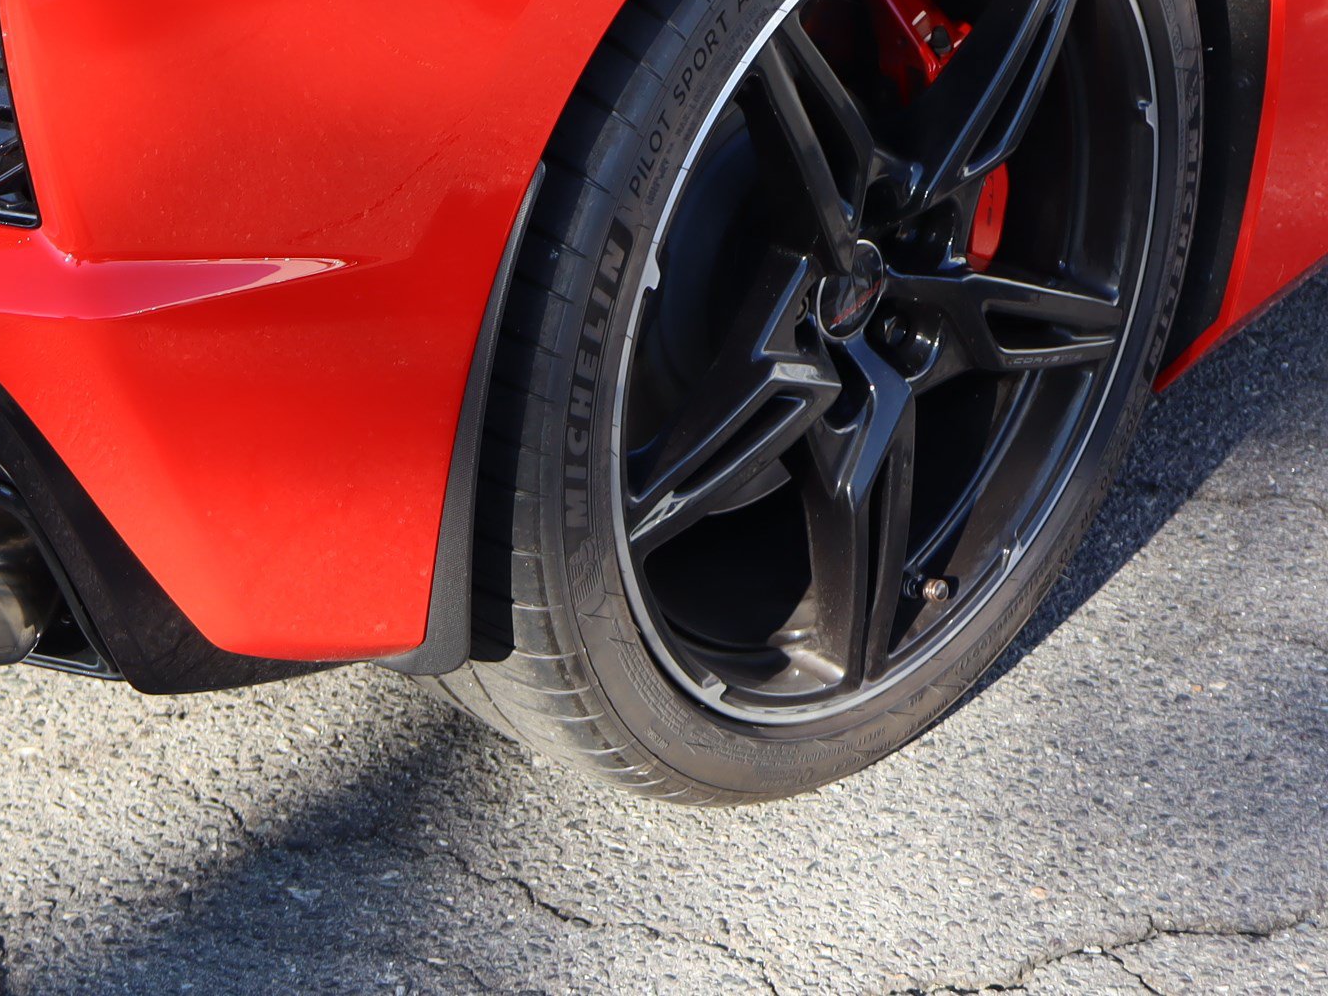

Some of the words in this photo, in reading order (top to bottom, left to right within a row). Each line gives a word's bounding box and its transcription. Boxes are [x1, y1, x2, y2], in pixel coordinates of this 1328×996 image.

[628, 110, 671, 199] PILOT
[673, 10, 729, 107] SPORT
[1149, 128, 1199, 366] MICHELIN
[565, 236, 626, 529] MICHELIN
